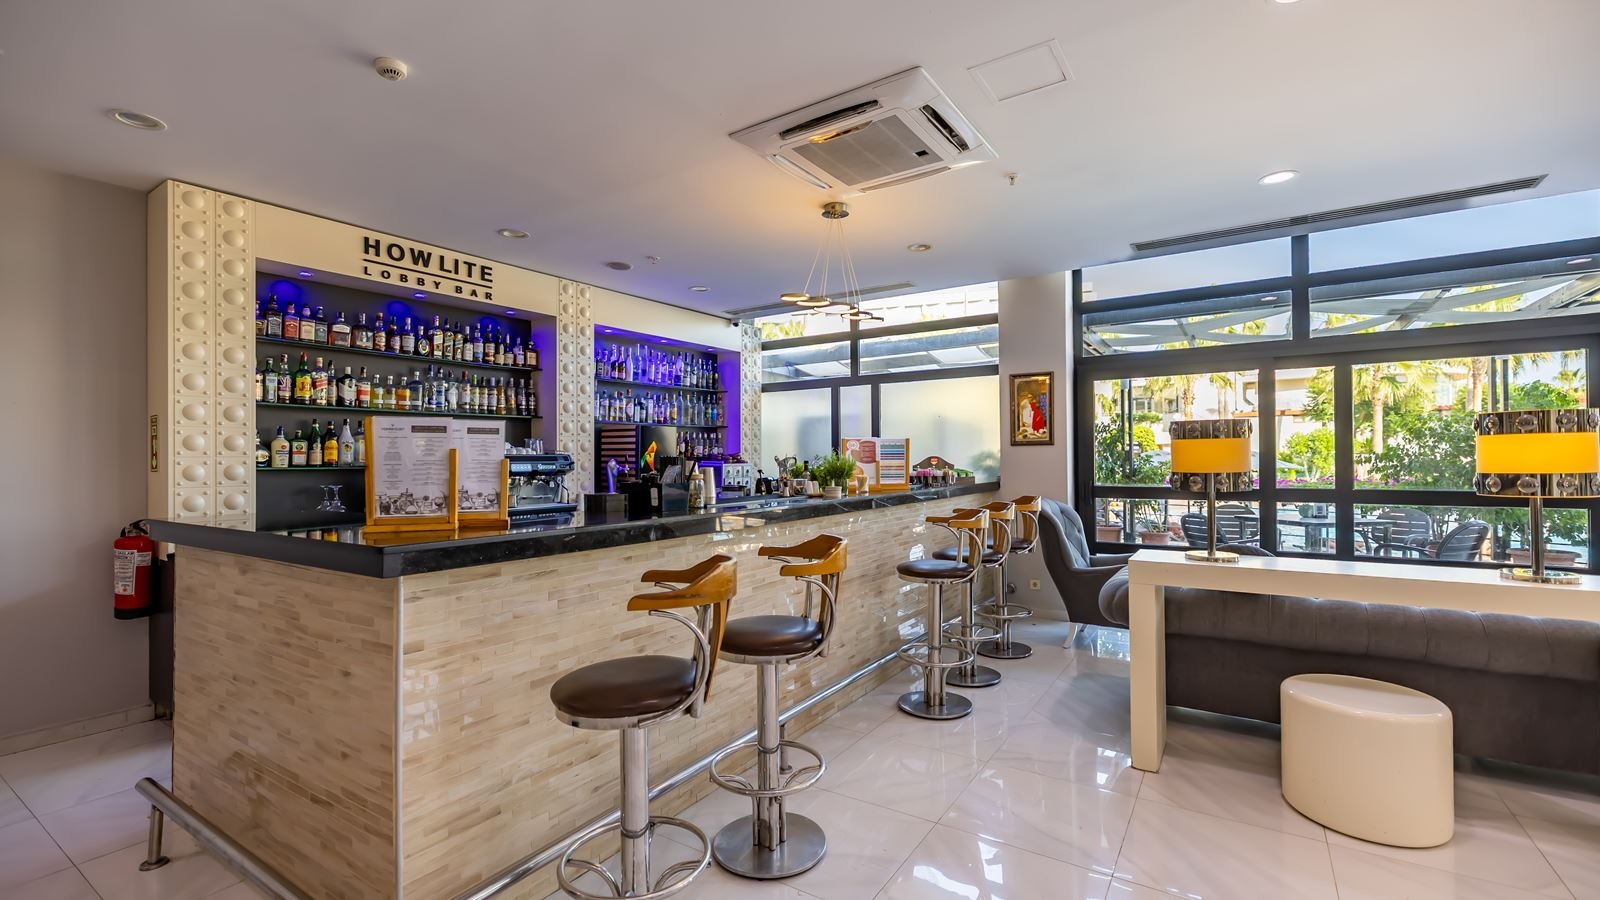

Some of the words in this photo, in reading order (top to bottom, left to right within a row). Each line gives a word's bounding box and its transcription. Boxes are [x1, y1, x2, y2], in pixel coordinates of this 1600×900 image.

[363, 236, 493, 283] HOWLITE
[363, 266, 442, 290] LOBBY
[455, 285, 493, 301] BAR
